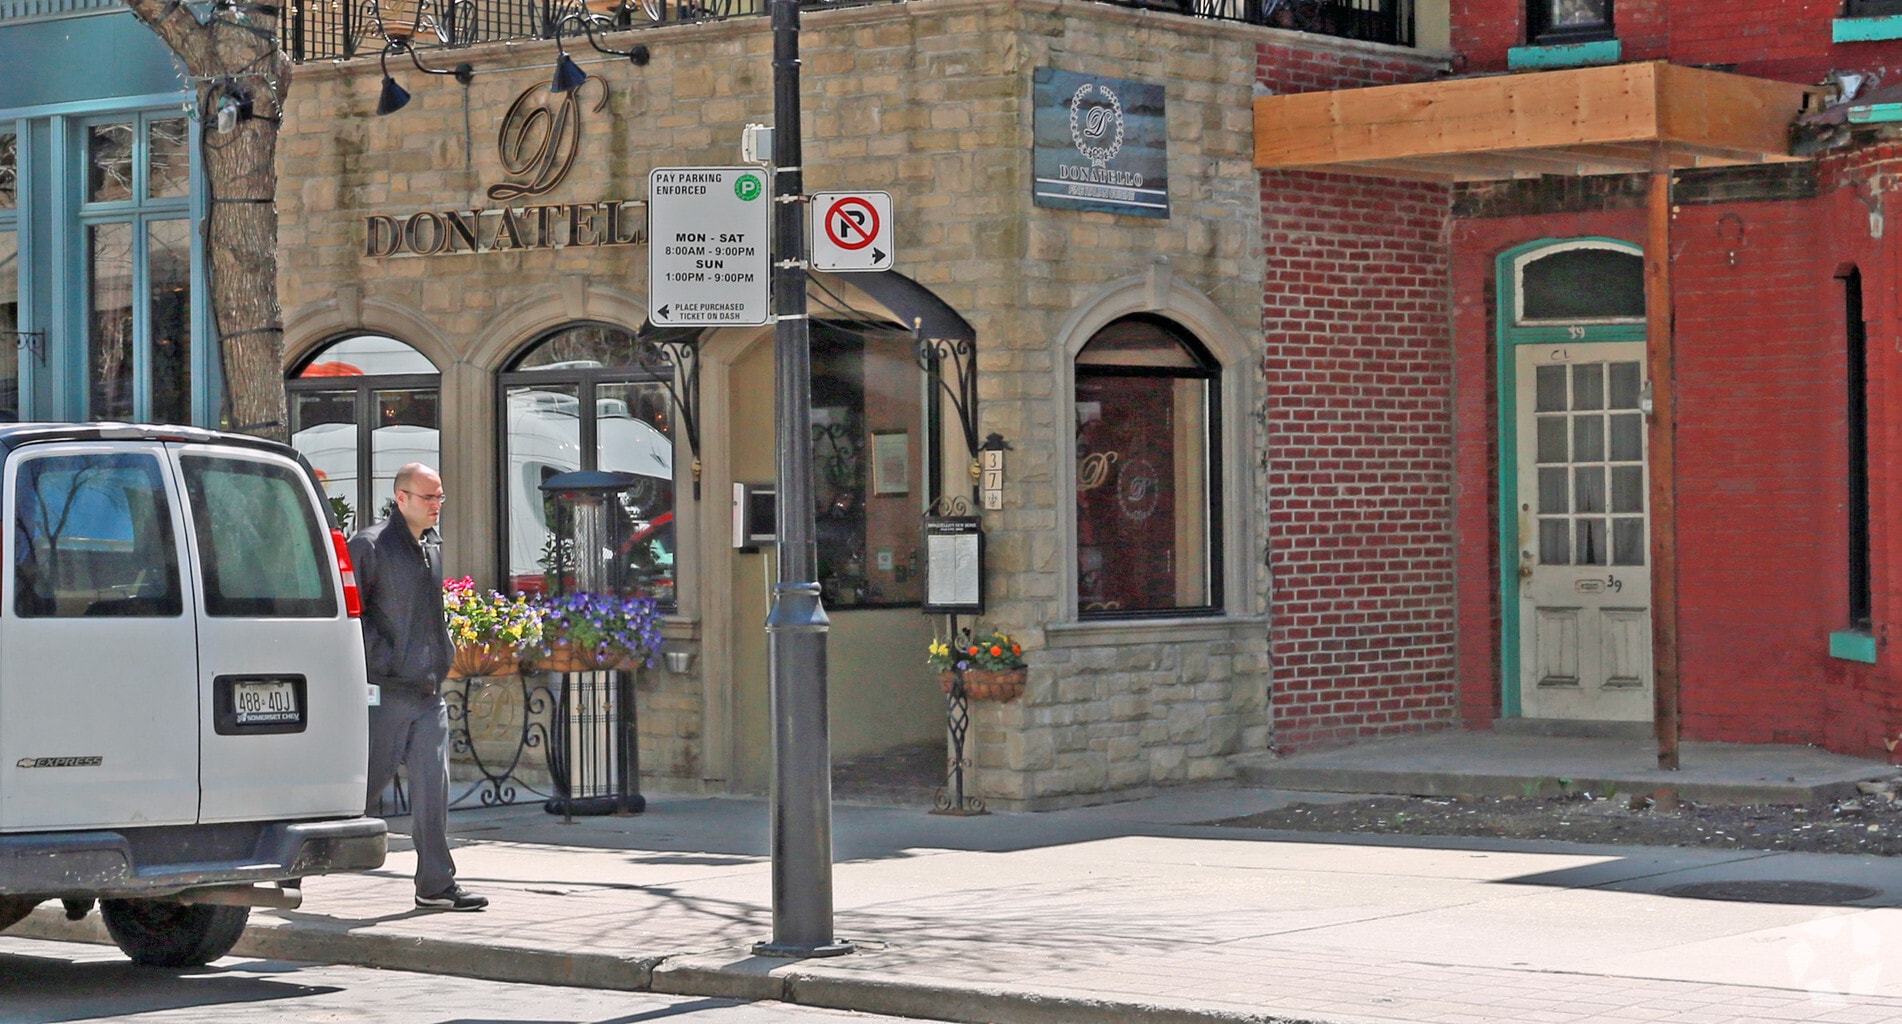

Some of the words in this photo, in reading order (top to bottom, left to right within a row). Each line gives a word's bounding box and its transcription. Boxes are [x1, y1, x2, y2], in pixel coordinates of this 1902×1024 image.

[487, 74, 610, 202] D
[656, 174, 676, 183] PAY
[679, 174, 722, 183] PARKING
[1059, 164, 1144, 187] DONATELLO
[656, 186, 706, 195] ENFORCED
[363, 200, 649, 258] DONATEL
[676, 233, 706, 242] MON
[719, 233, 745, 243] SAT
[665, 246, 705, 256] 8:00AM
[715, 247, 755, 256] 9:00PM
[696, 260, 723, 269] SUN
[666, 273, 704, 282] 1:00PM
[714, 273, 754, 283] 9:00PM
[675, 303, 698, 311] PLACE
[700, 303, 745, 311] PURCHASED
[680, 312, 705, 320] TICKET
[707, 312, 717, 320] ON
[719, 312, 740, 320] DASH
[1607, 574, 1622, 593] 39
[240, 692, 261, 711] 488
[36, 757, 102, 767] EXPRESS
